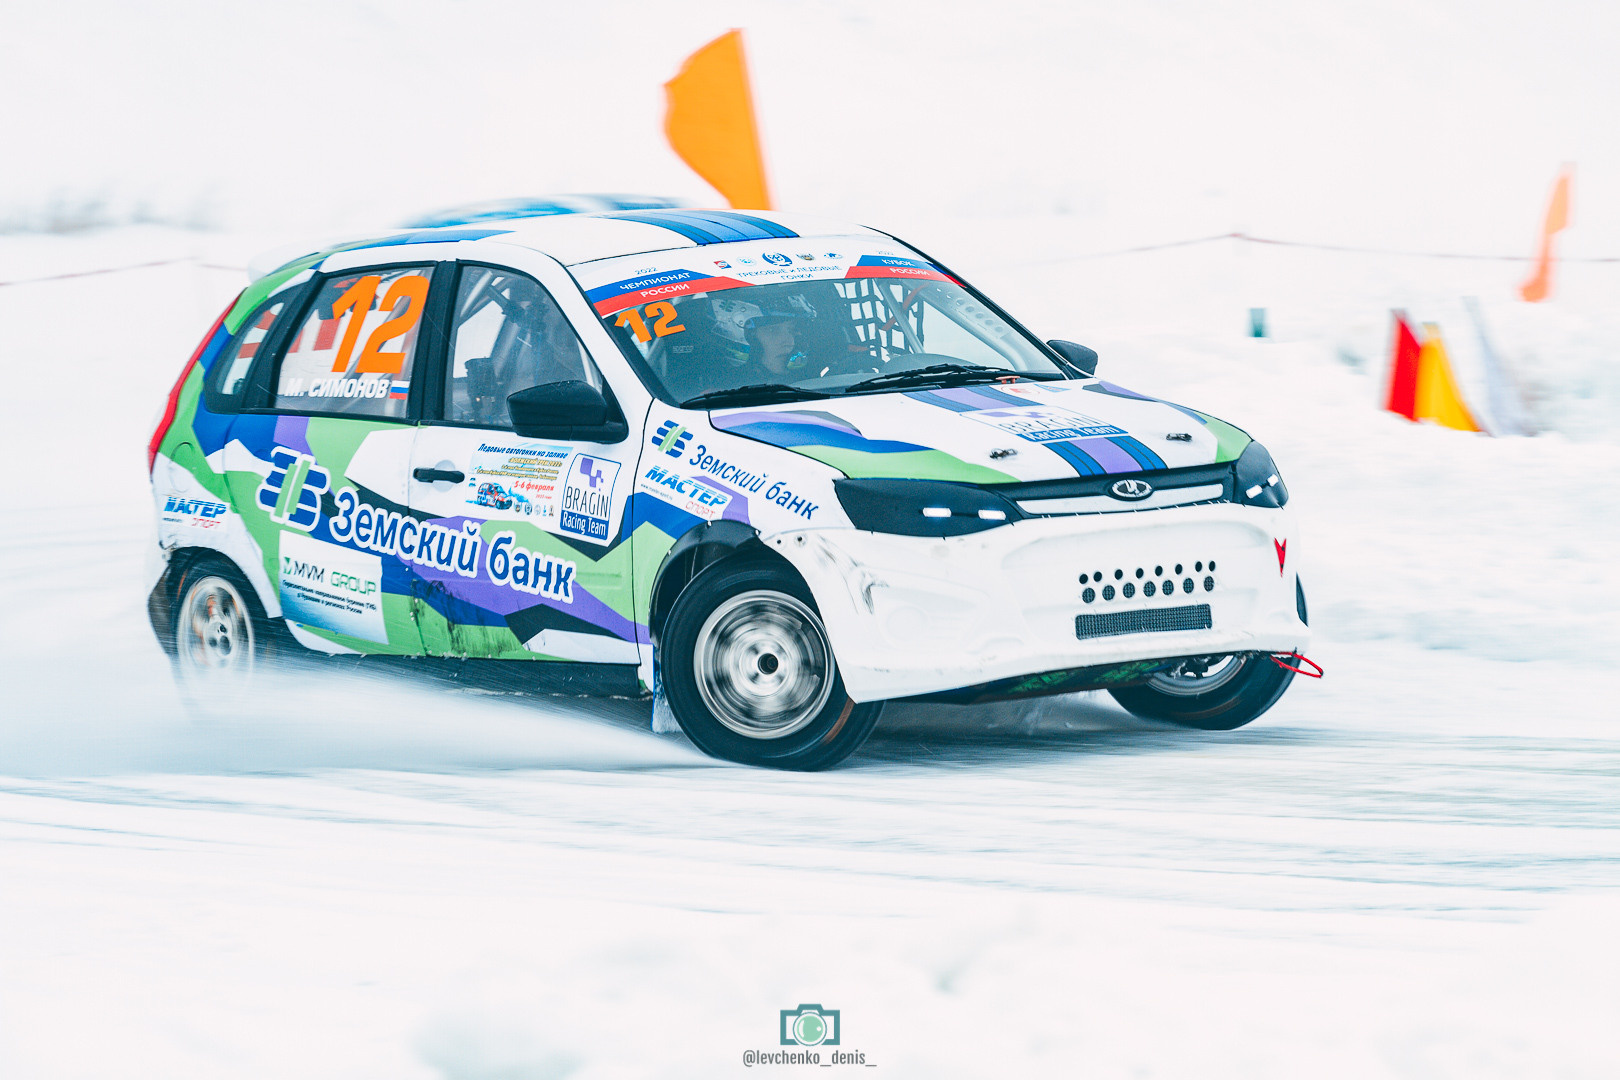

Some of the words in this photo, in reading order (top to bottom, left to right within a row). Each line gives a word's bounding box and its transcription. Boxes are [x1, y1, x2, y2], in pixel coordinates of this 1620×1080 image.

[620, 273, 691, 290] ЧЕМПИОНАТ
[634, 267, 658, 275] 2022
[640, 283, 690, 298] РОССИИ
[331, 275, 430, 374] 12
[614, 301, 686, 343] 12
[284, 378, 305, 397] М.
[308, 378, 391, 399] СИМОНОВ
[1021, 428, 1082, 442] Racing
[1078, 425, 1120, 436] Team
[478, 443, 505, 454] Ледовые
[506, 447, 538, 456] автогонки
[545, 450, 569, 459] заливе
[514, 480, 525, 489] 5-6
[526, 482, 555, 492] февраля
[645, 465, 728, 506] МАСТЕР
[689, 444, 770, 493] Земский
[765, 481, 819, 520] банк
[164, 496, 227, 518] МАСТЕР
[564, 486, 609, 518] BRAGIN
[685, 501, 715, 519] СПОРТ
[562, 511, 586, 535] Racing
[587, 519, 607, 536] Team
[331, 490, 479, 573] Земский
[489, 535, 574, 598] банк
[294, 560, 325, 583] MVM
[331, 571, 377, 596] GROUP
